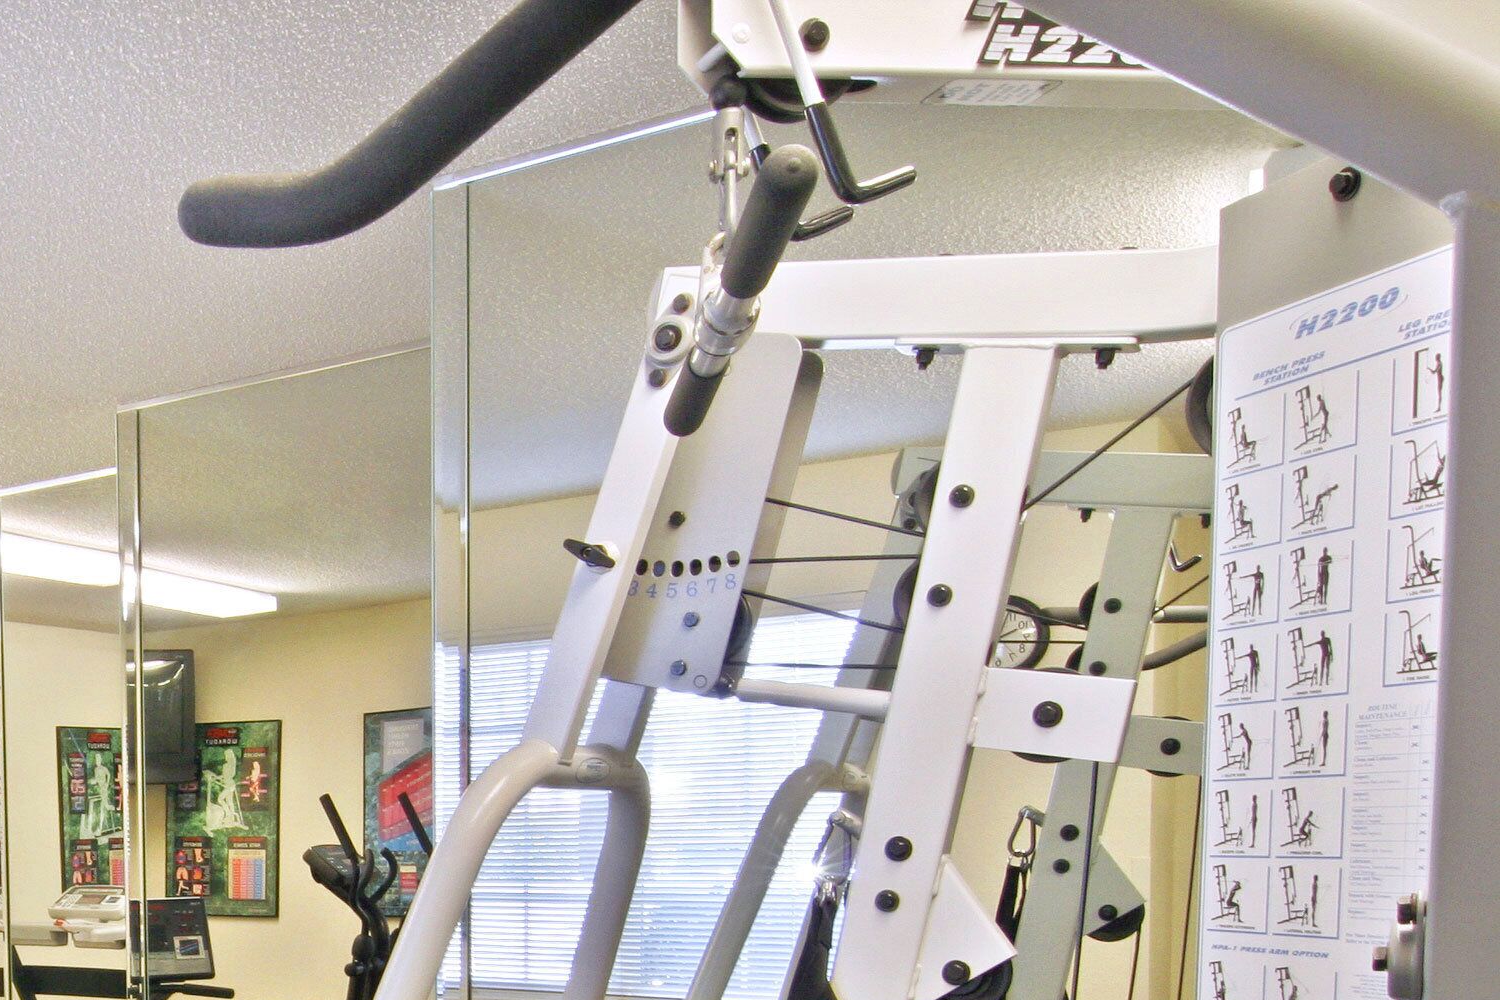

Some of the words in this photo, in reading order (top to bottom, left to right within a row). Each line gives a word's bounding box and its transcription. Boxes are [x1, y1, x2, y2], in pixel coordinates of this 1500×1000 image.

[1294, 291, 1400, 340] H2200
[1252, 364, 1289, 382] BENCH
[1262, 365, 1310, 386] STATION
[646, 583, 657, 599] 4
[666, 582, 678, 599] 5
[686, 581, 698, 598] 6
[706, 577, 717, 594] 7
[725, 573, 737, 590] 8
[1292, 950, 1330, 959] OPTION
